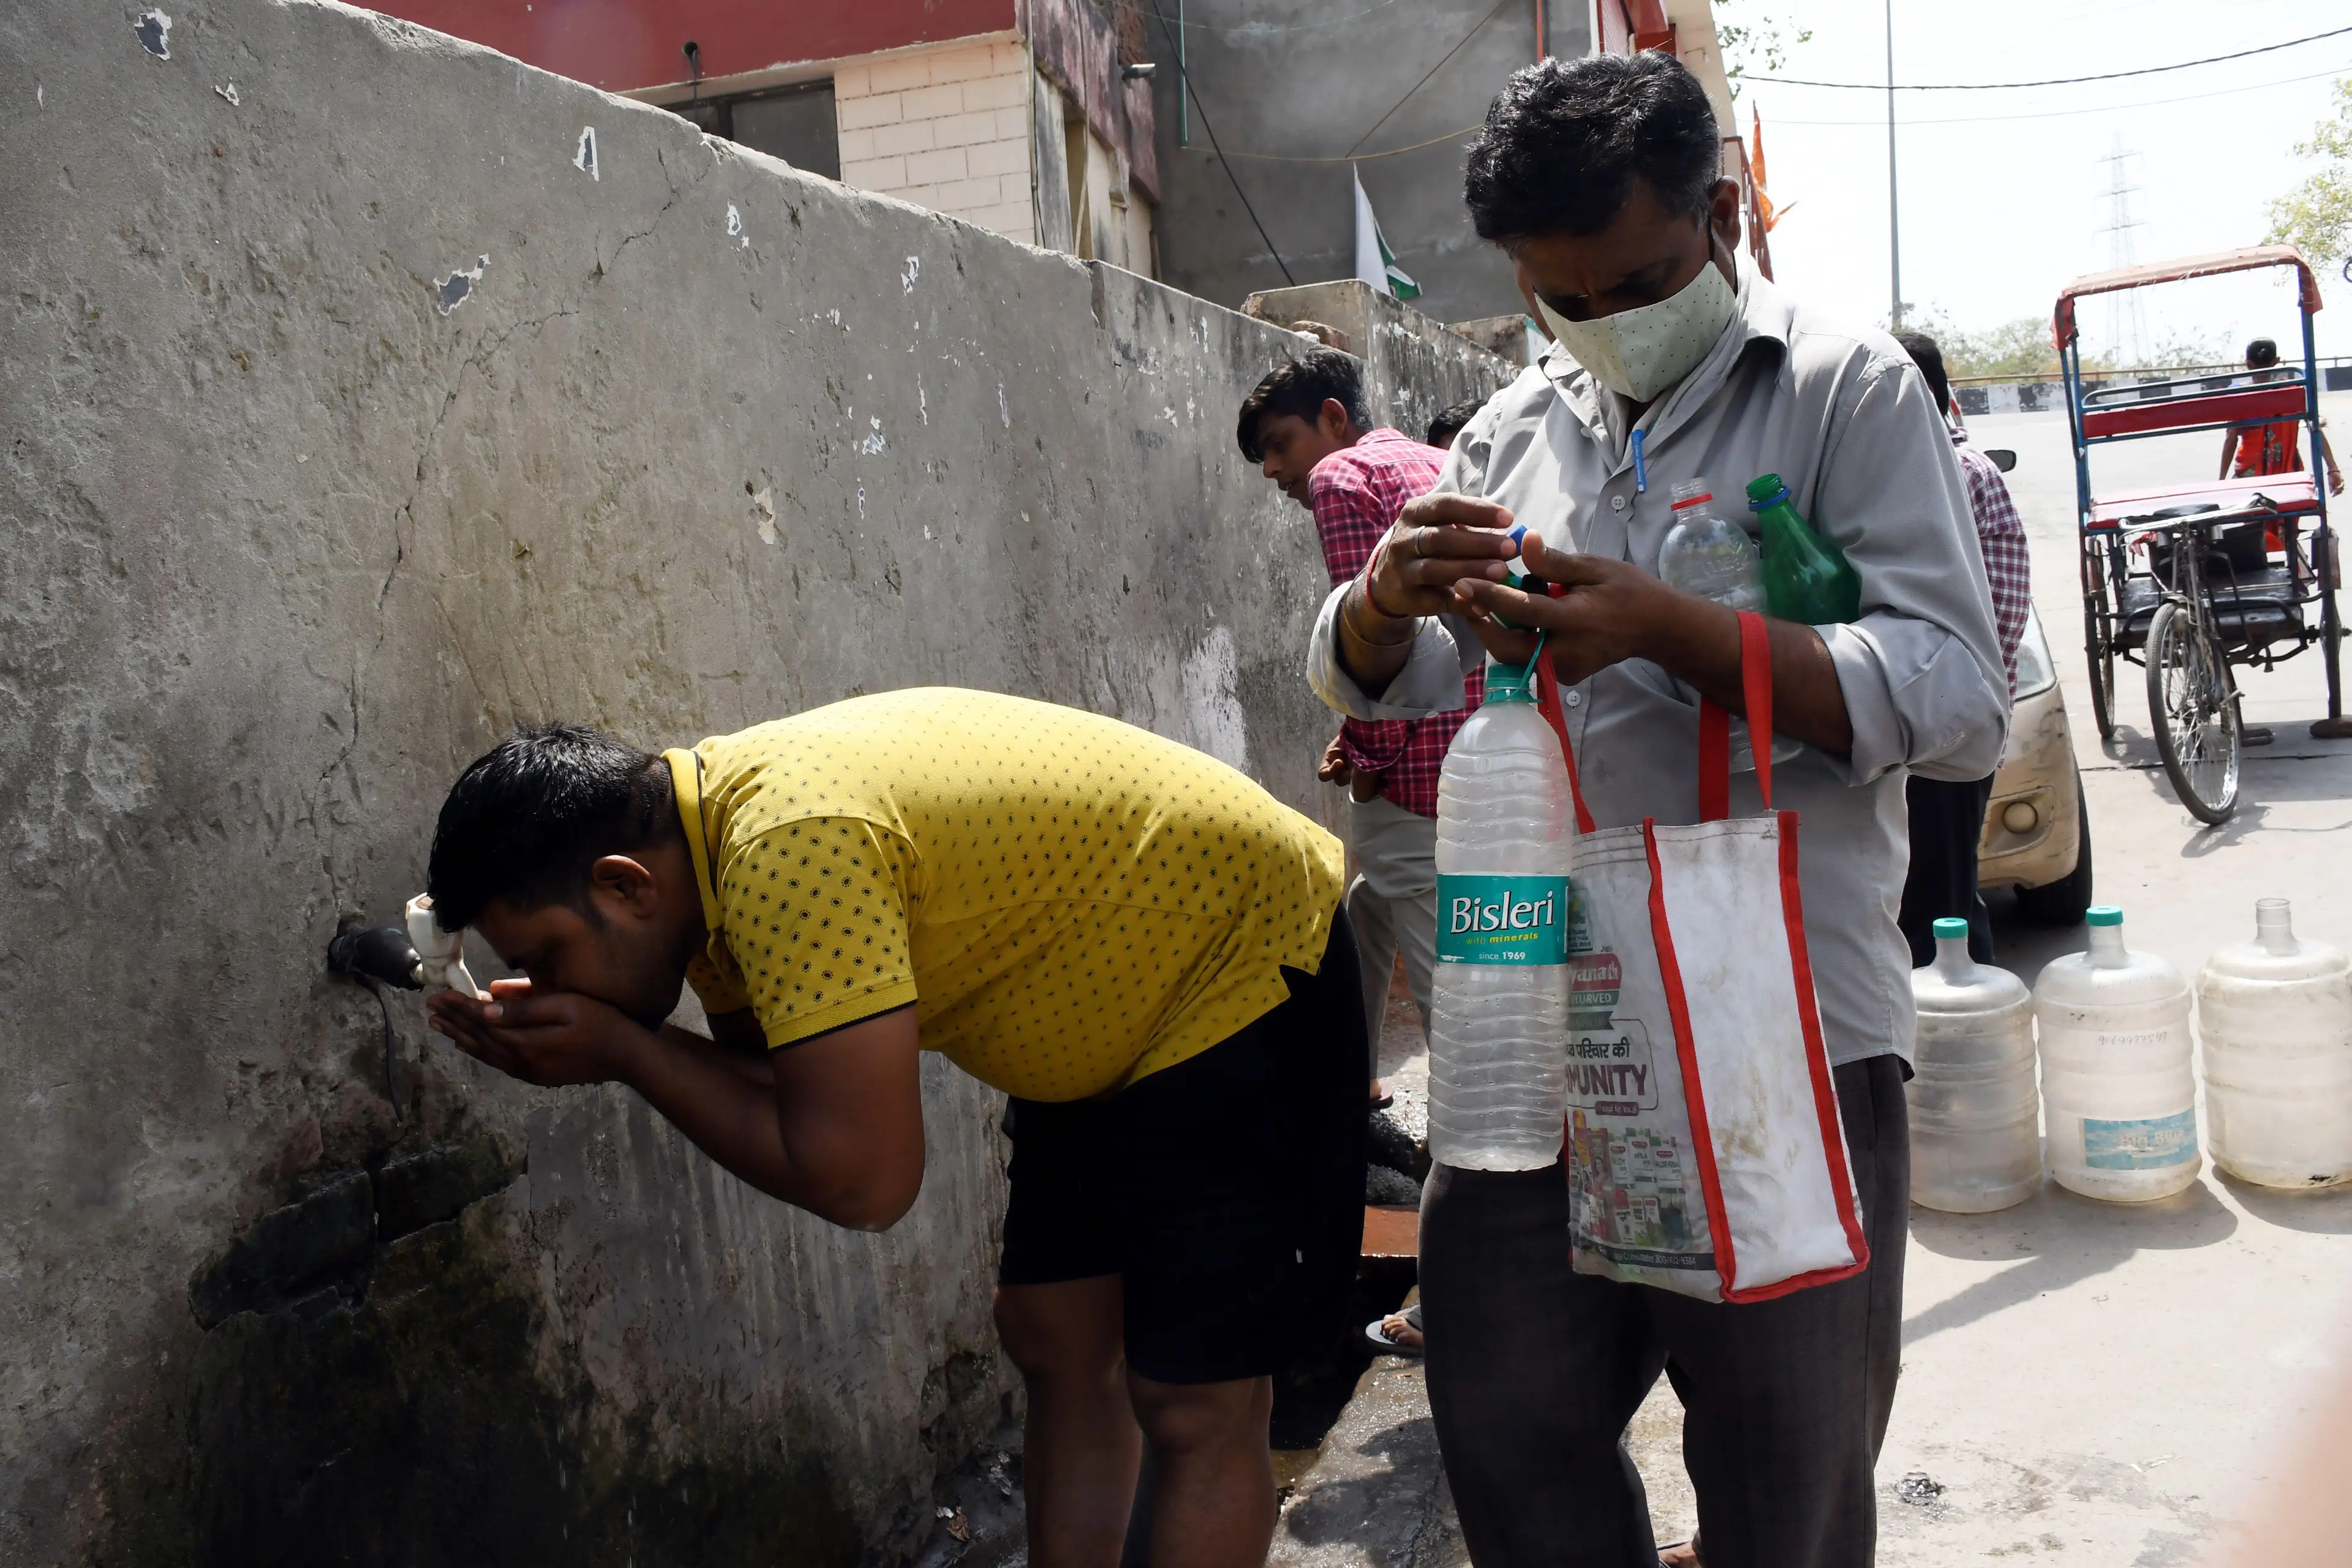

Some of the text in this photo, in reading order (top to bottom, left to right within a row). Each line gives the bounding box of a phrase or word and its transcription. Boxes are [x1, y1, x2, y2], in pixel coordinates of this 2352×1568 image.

[1450, 891, 1553, 935] Bisleri
[1489, 932, 1539, 944] minerals
[1479, 951, 1526, 960] since 1969
[1567, 961, 1619, 986] yanath
[1575, 1038, 1610, 1058] परिवार
[1611, 1036, 1630, 1058] की
